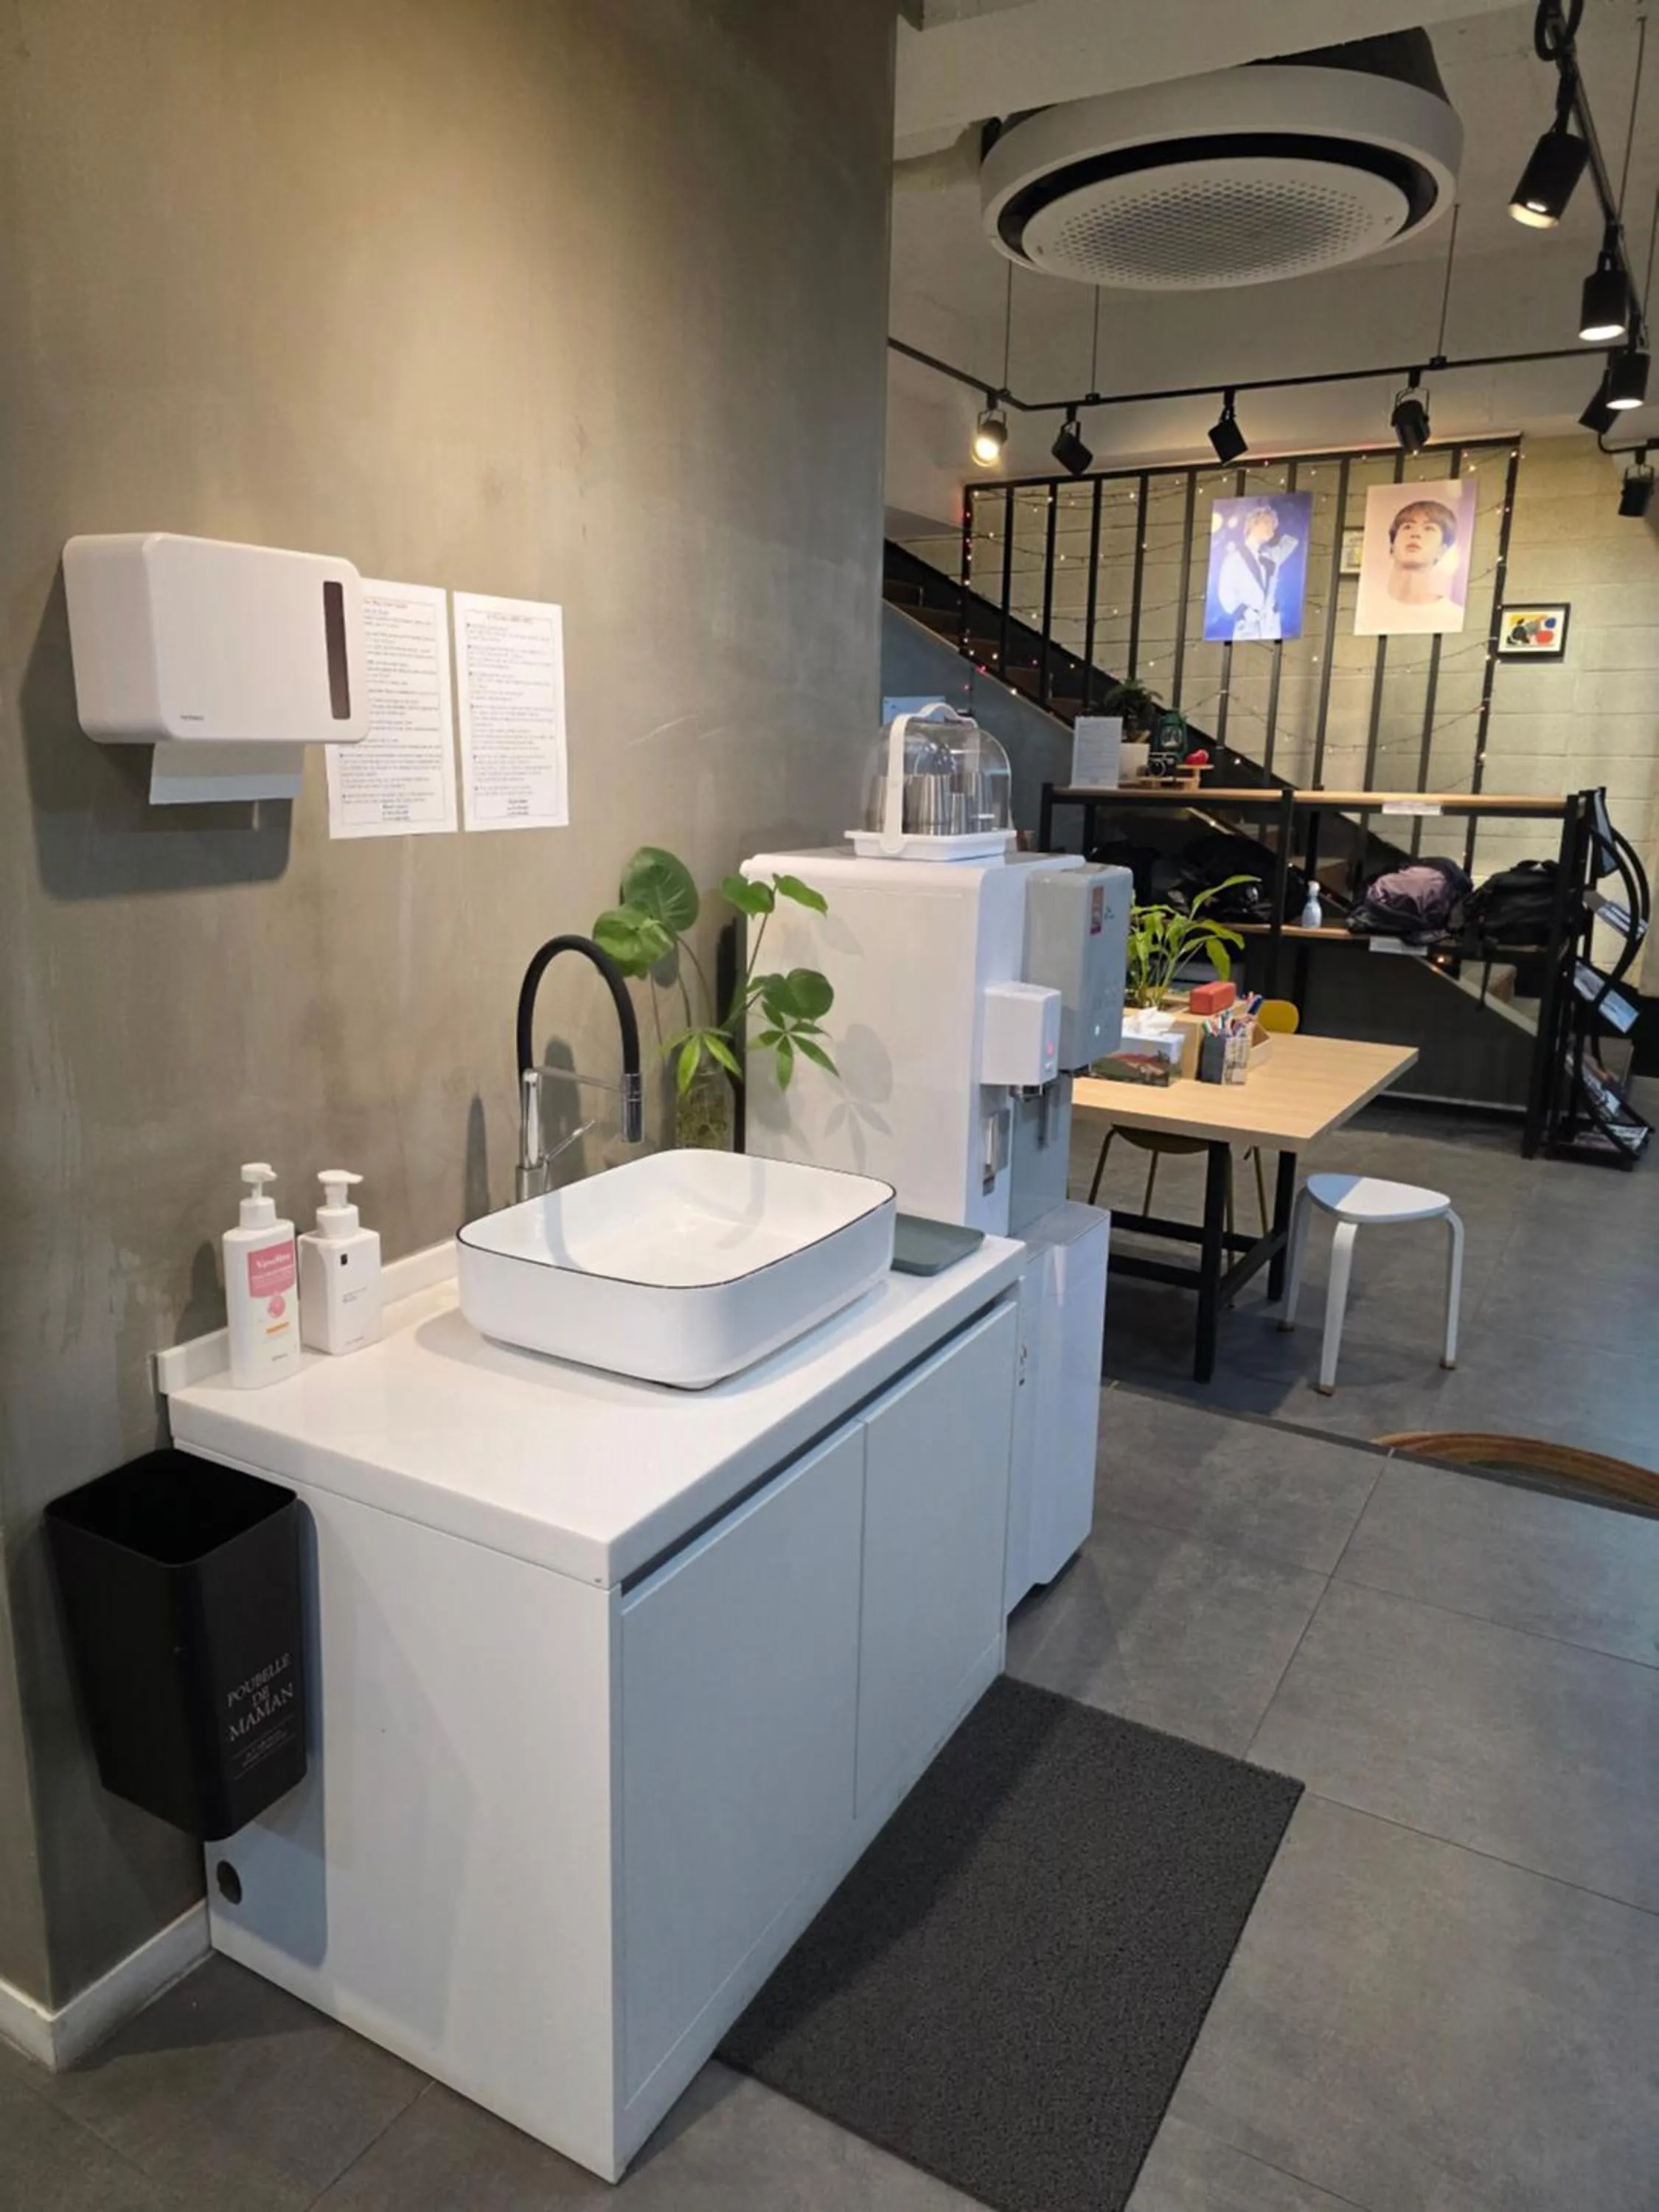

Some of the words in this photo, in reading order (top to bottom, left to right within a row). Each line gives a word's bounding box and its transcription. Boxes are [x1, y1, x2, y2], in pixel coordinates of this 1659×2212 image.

[227, 1652, 293, 1708] POUBELLE
[251, 1686, 270, 1707] DE
[229, 1682, 293, 1742] MAMAN
